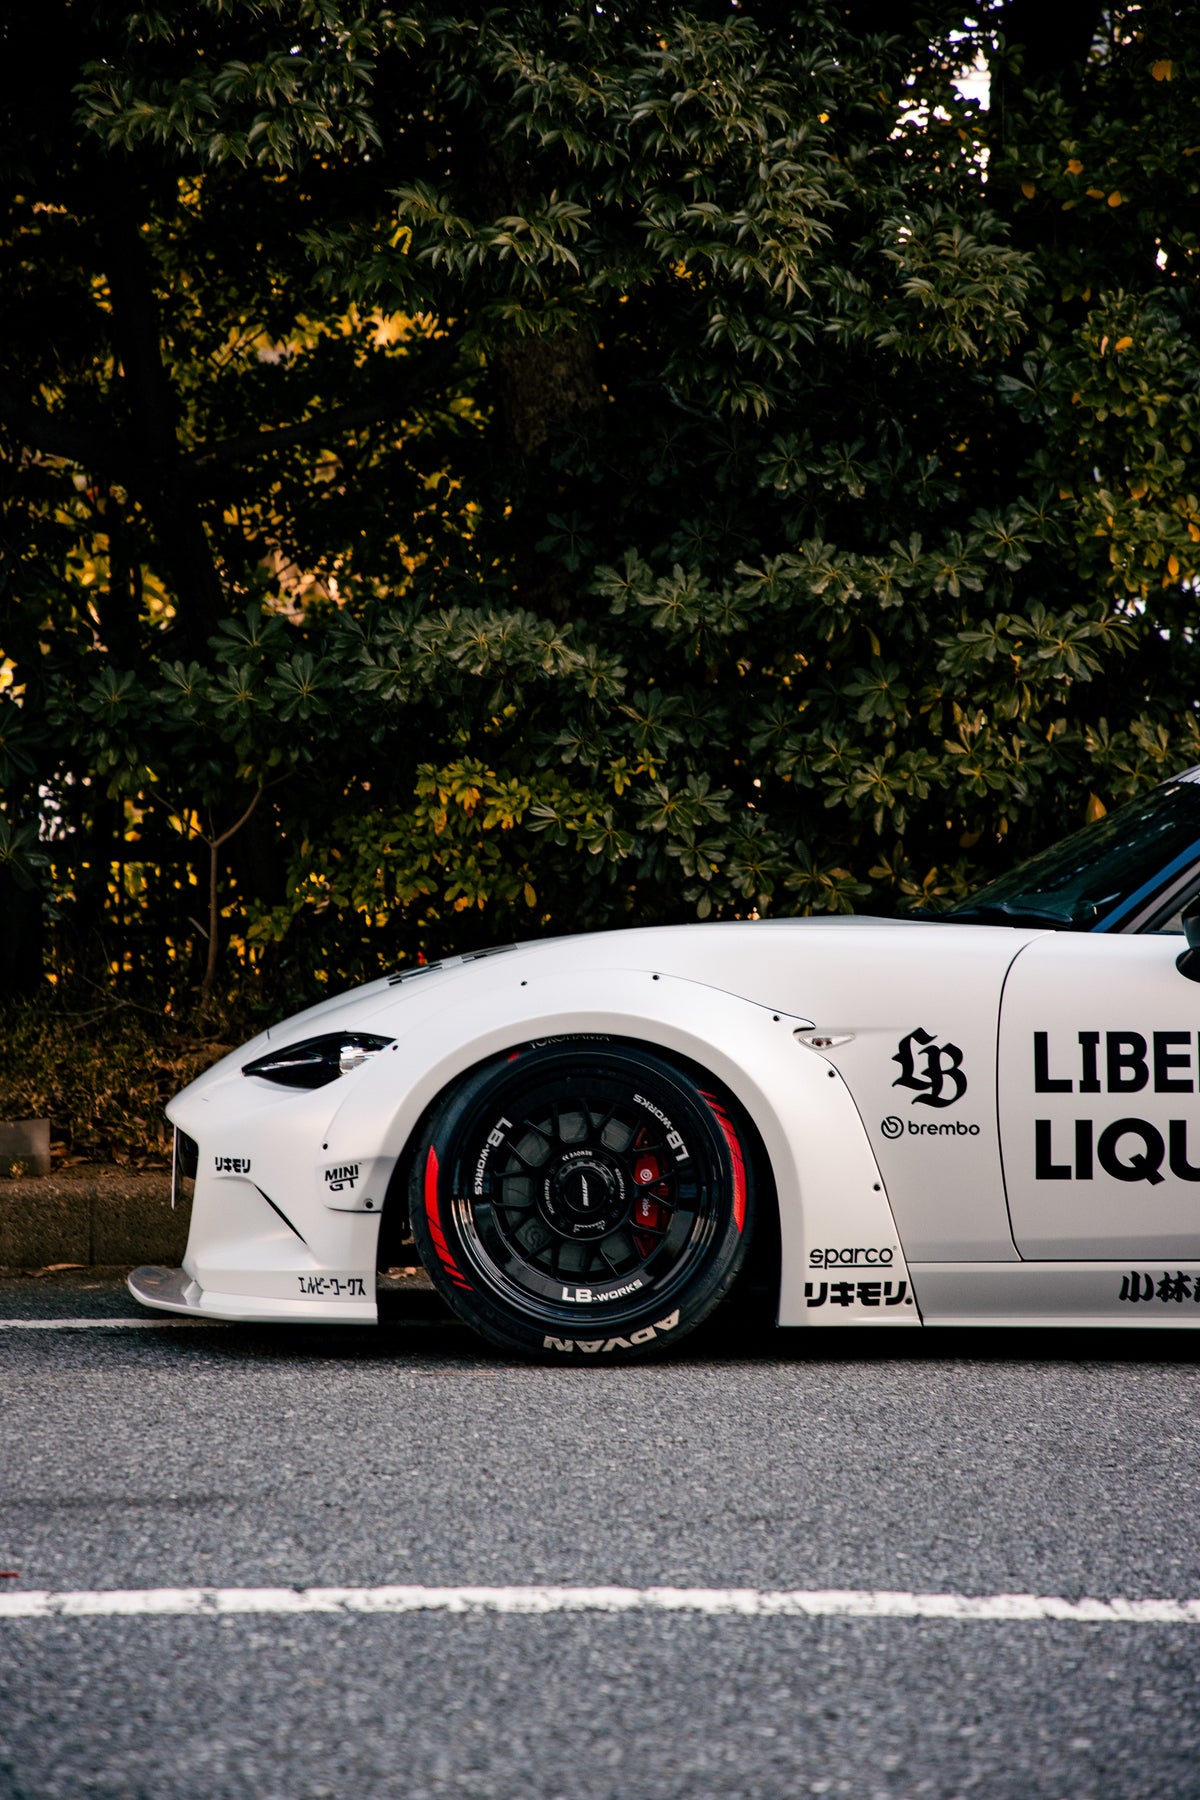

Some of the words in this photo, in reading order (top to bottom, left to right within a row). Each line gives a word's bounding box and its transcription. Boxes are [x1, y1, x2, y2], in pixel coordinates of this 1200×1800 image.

[1034, 1031, 1200, 1093] LIBE
[908, 1120, 980, 1135] brembo
[215, 1156, 251, 1174] リキモリ
[325, 1164, 359, 1181] MINI
[330, 1176, 359, 1191] GT
[809, 1248, 894, 1269] sparco
[543, 1308, 681, 1353] ADVAN
